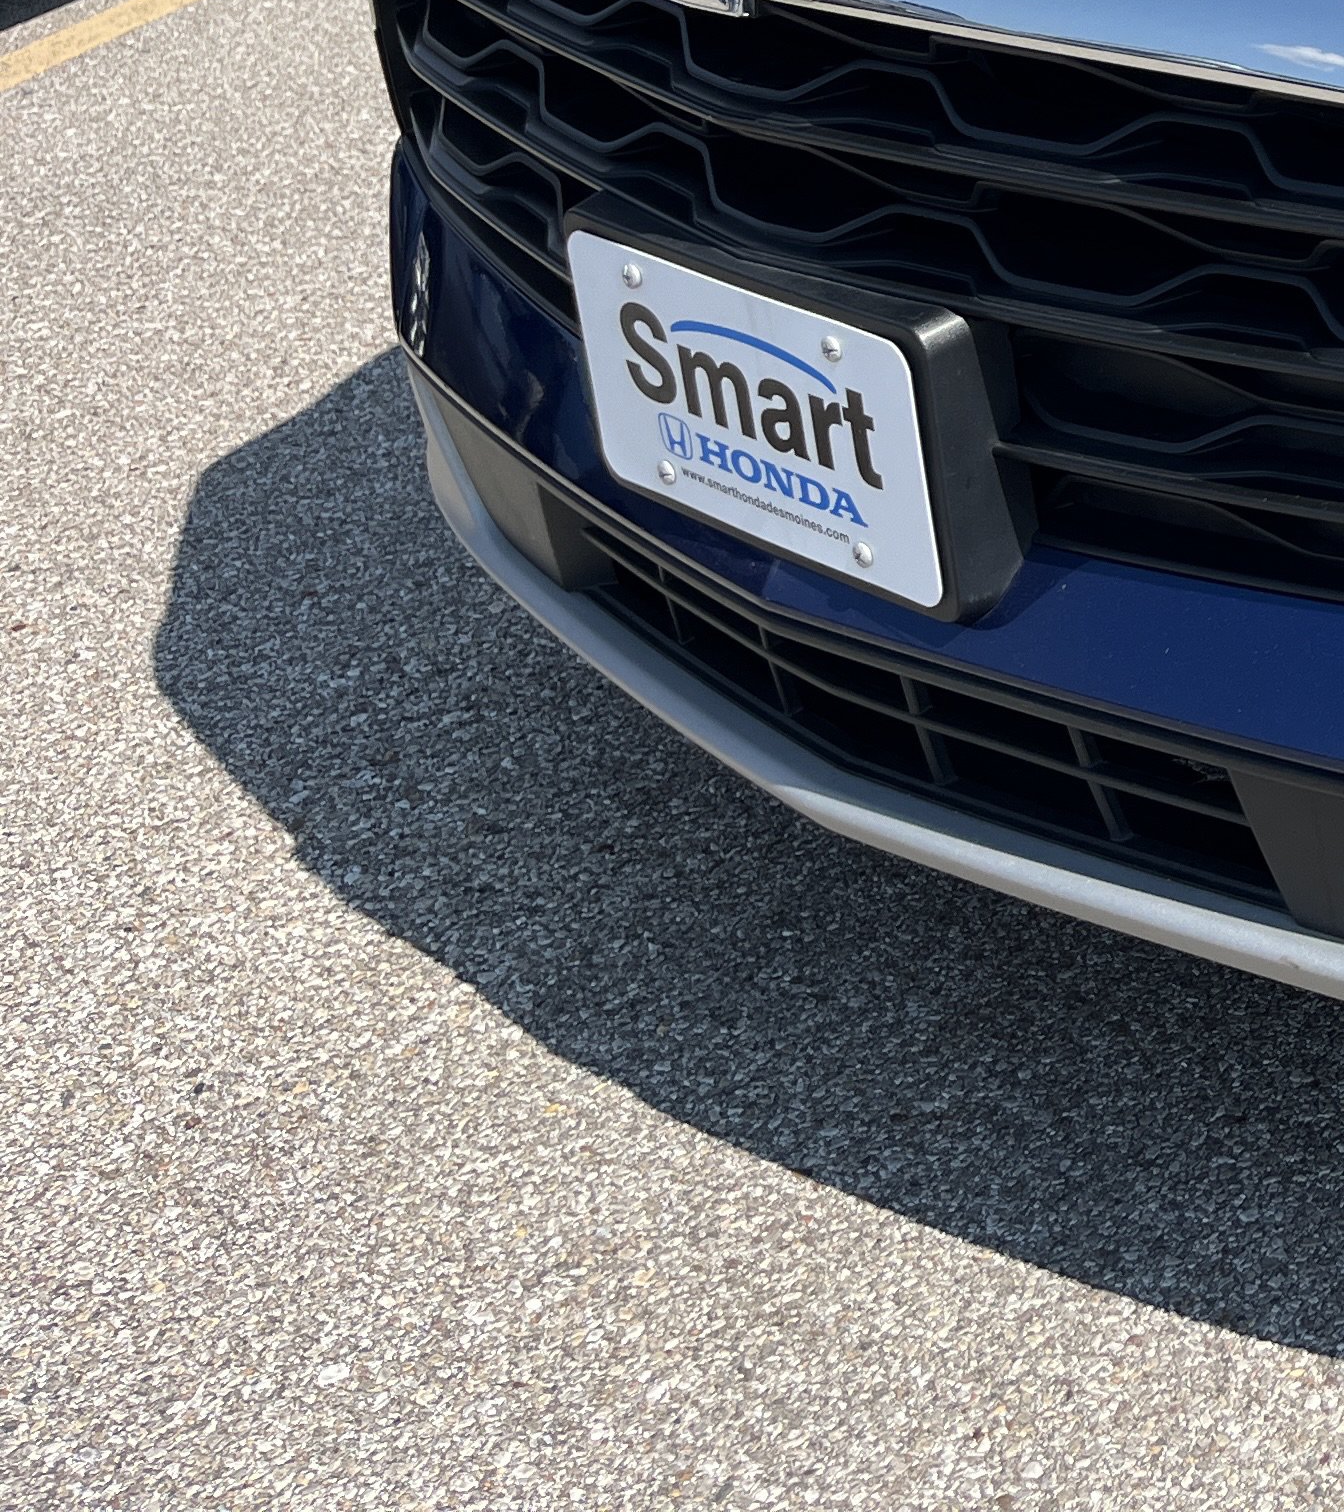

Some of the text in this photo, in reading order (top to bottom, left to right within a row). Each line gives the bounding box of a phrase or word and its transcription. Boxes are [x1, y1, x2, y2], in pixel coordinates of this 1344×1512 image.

[619, 301, 884, 490] Smart
[681, 467, 850, 544] www.smarthondadesmoines.com
[696, 433, 869, 528] HONDA
